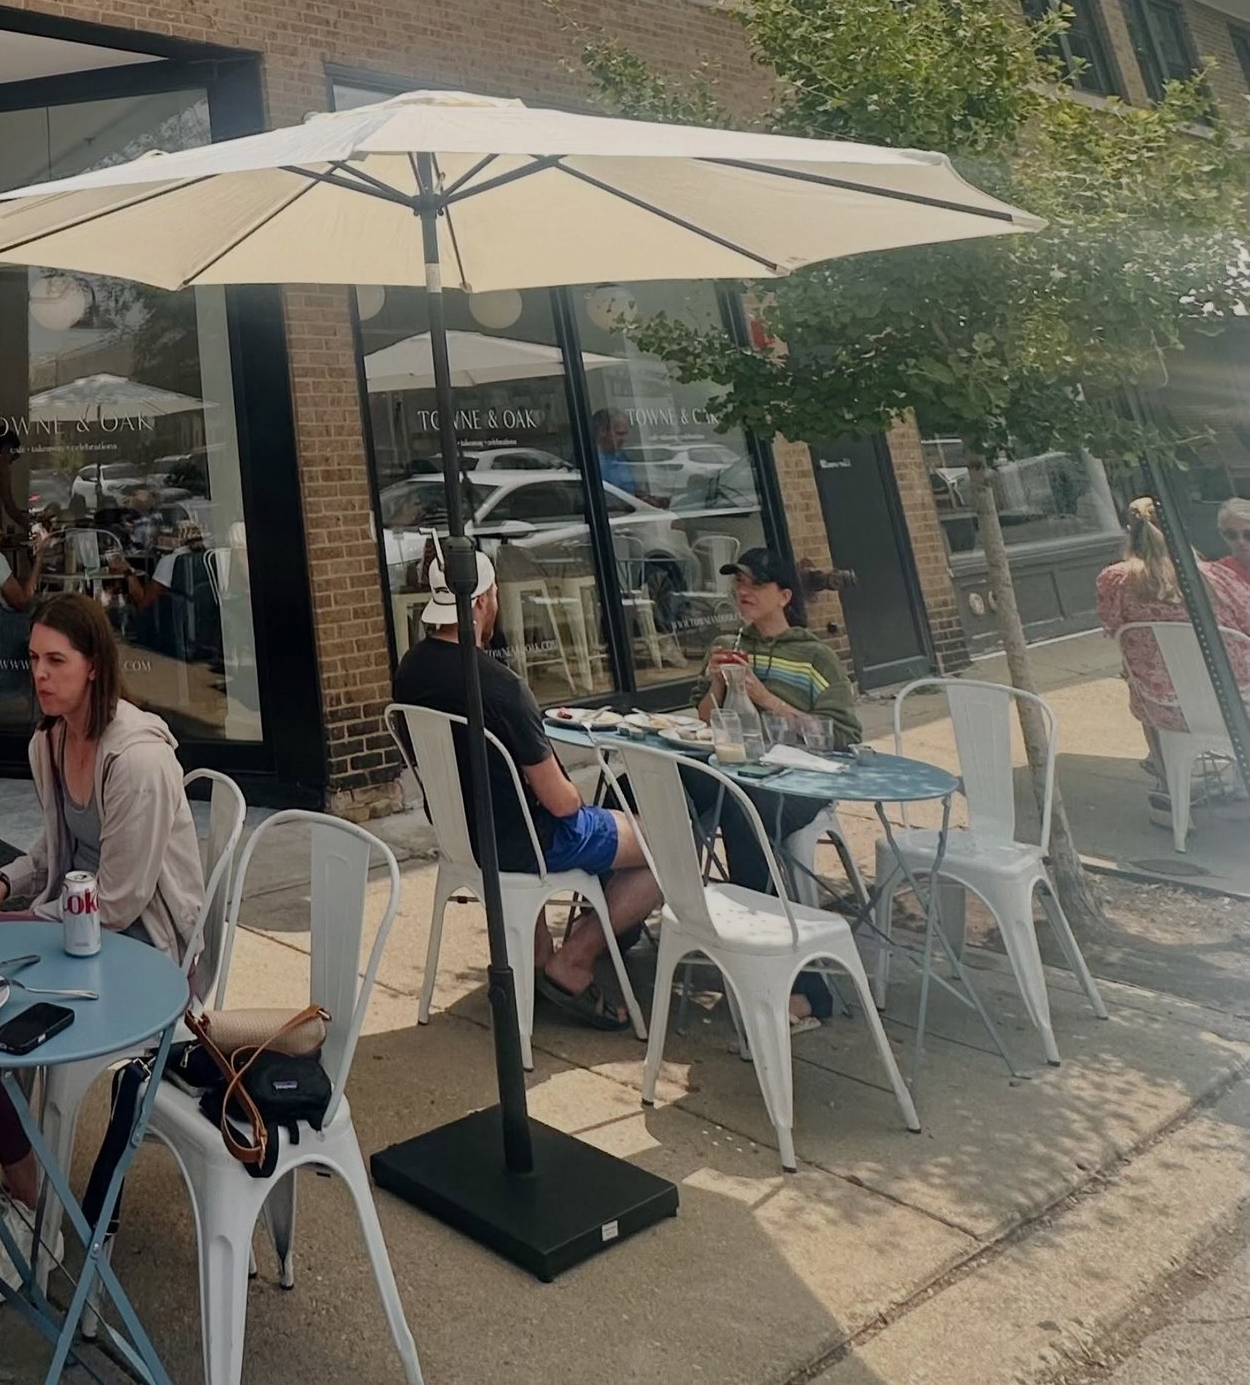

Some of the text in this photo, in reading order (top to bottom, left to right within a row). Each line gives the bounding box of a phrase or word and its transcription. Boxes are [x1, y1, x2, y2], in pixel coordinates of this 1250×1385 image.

[76, 414, 91, 434] &
[101, 411, 154, 433] OAK
[488, 409, 499, 429] &
[503, 409, 538, 430] OAK
[680, 408, 690, 425] &
